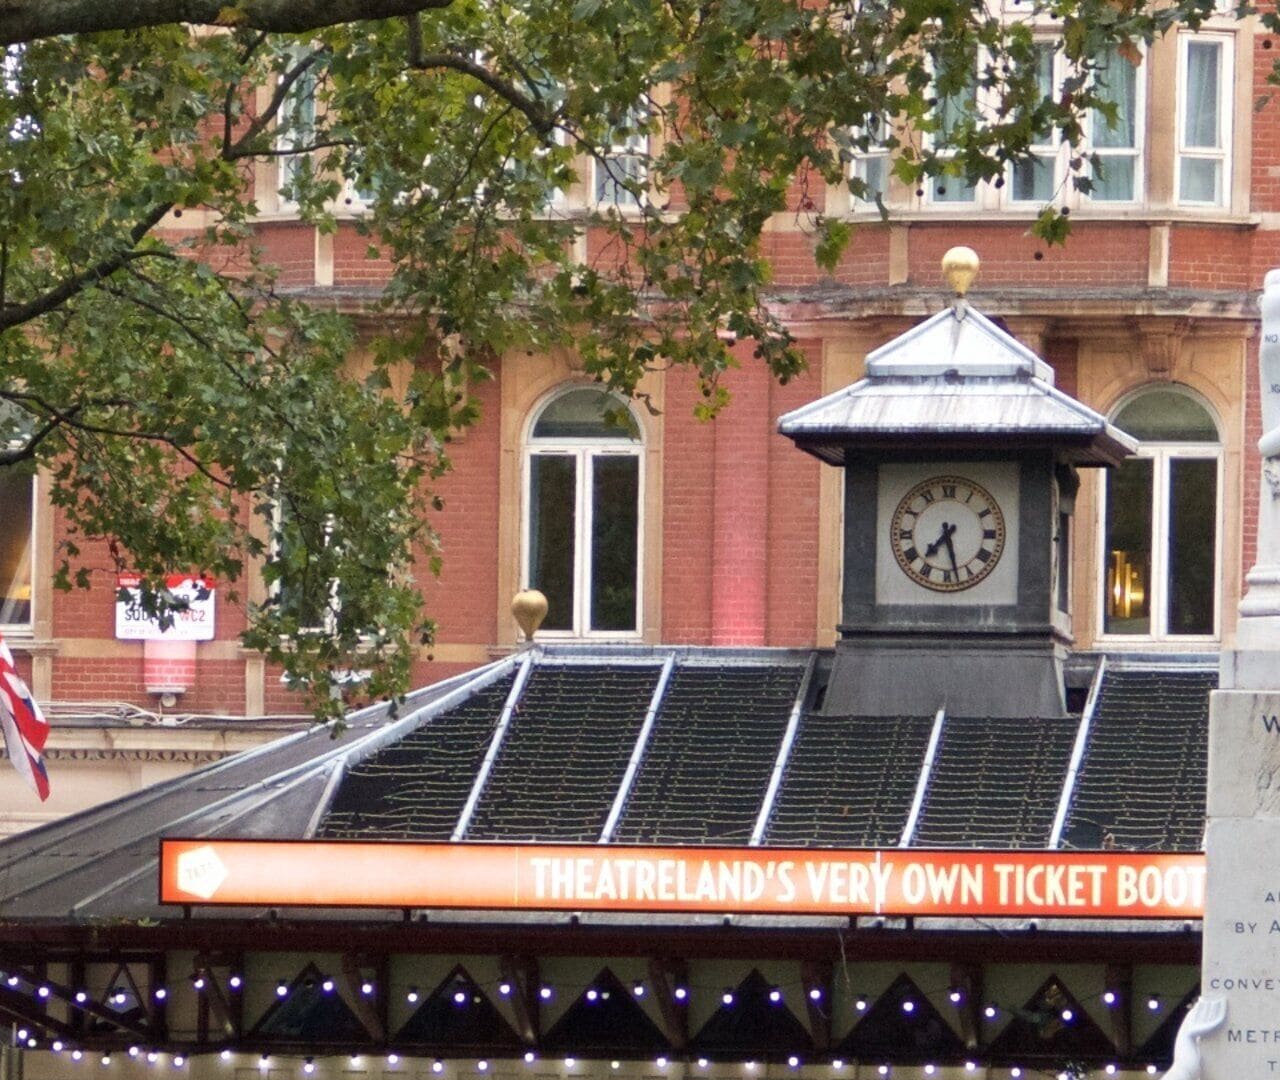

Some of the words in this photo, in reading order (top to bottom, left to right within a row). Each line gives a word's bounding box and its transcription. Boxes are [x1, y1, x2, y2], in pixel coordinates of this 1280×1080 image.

[1265, 334, 1278, 343] NO
[530, 857, 795, 903] THEATRELAND'S
[805, 861, 893, 904] VERY
[902, 862, 983, 906] OWN
[994, 863, 1107, 907] TICKET
[1235, 922, 1257, 934] BY
